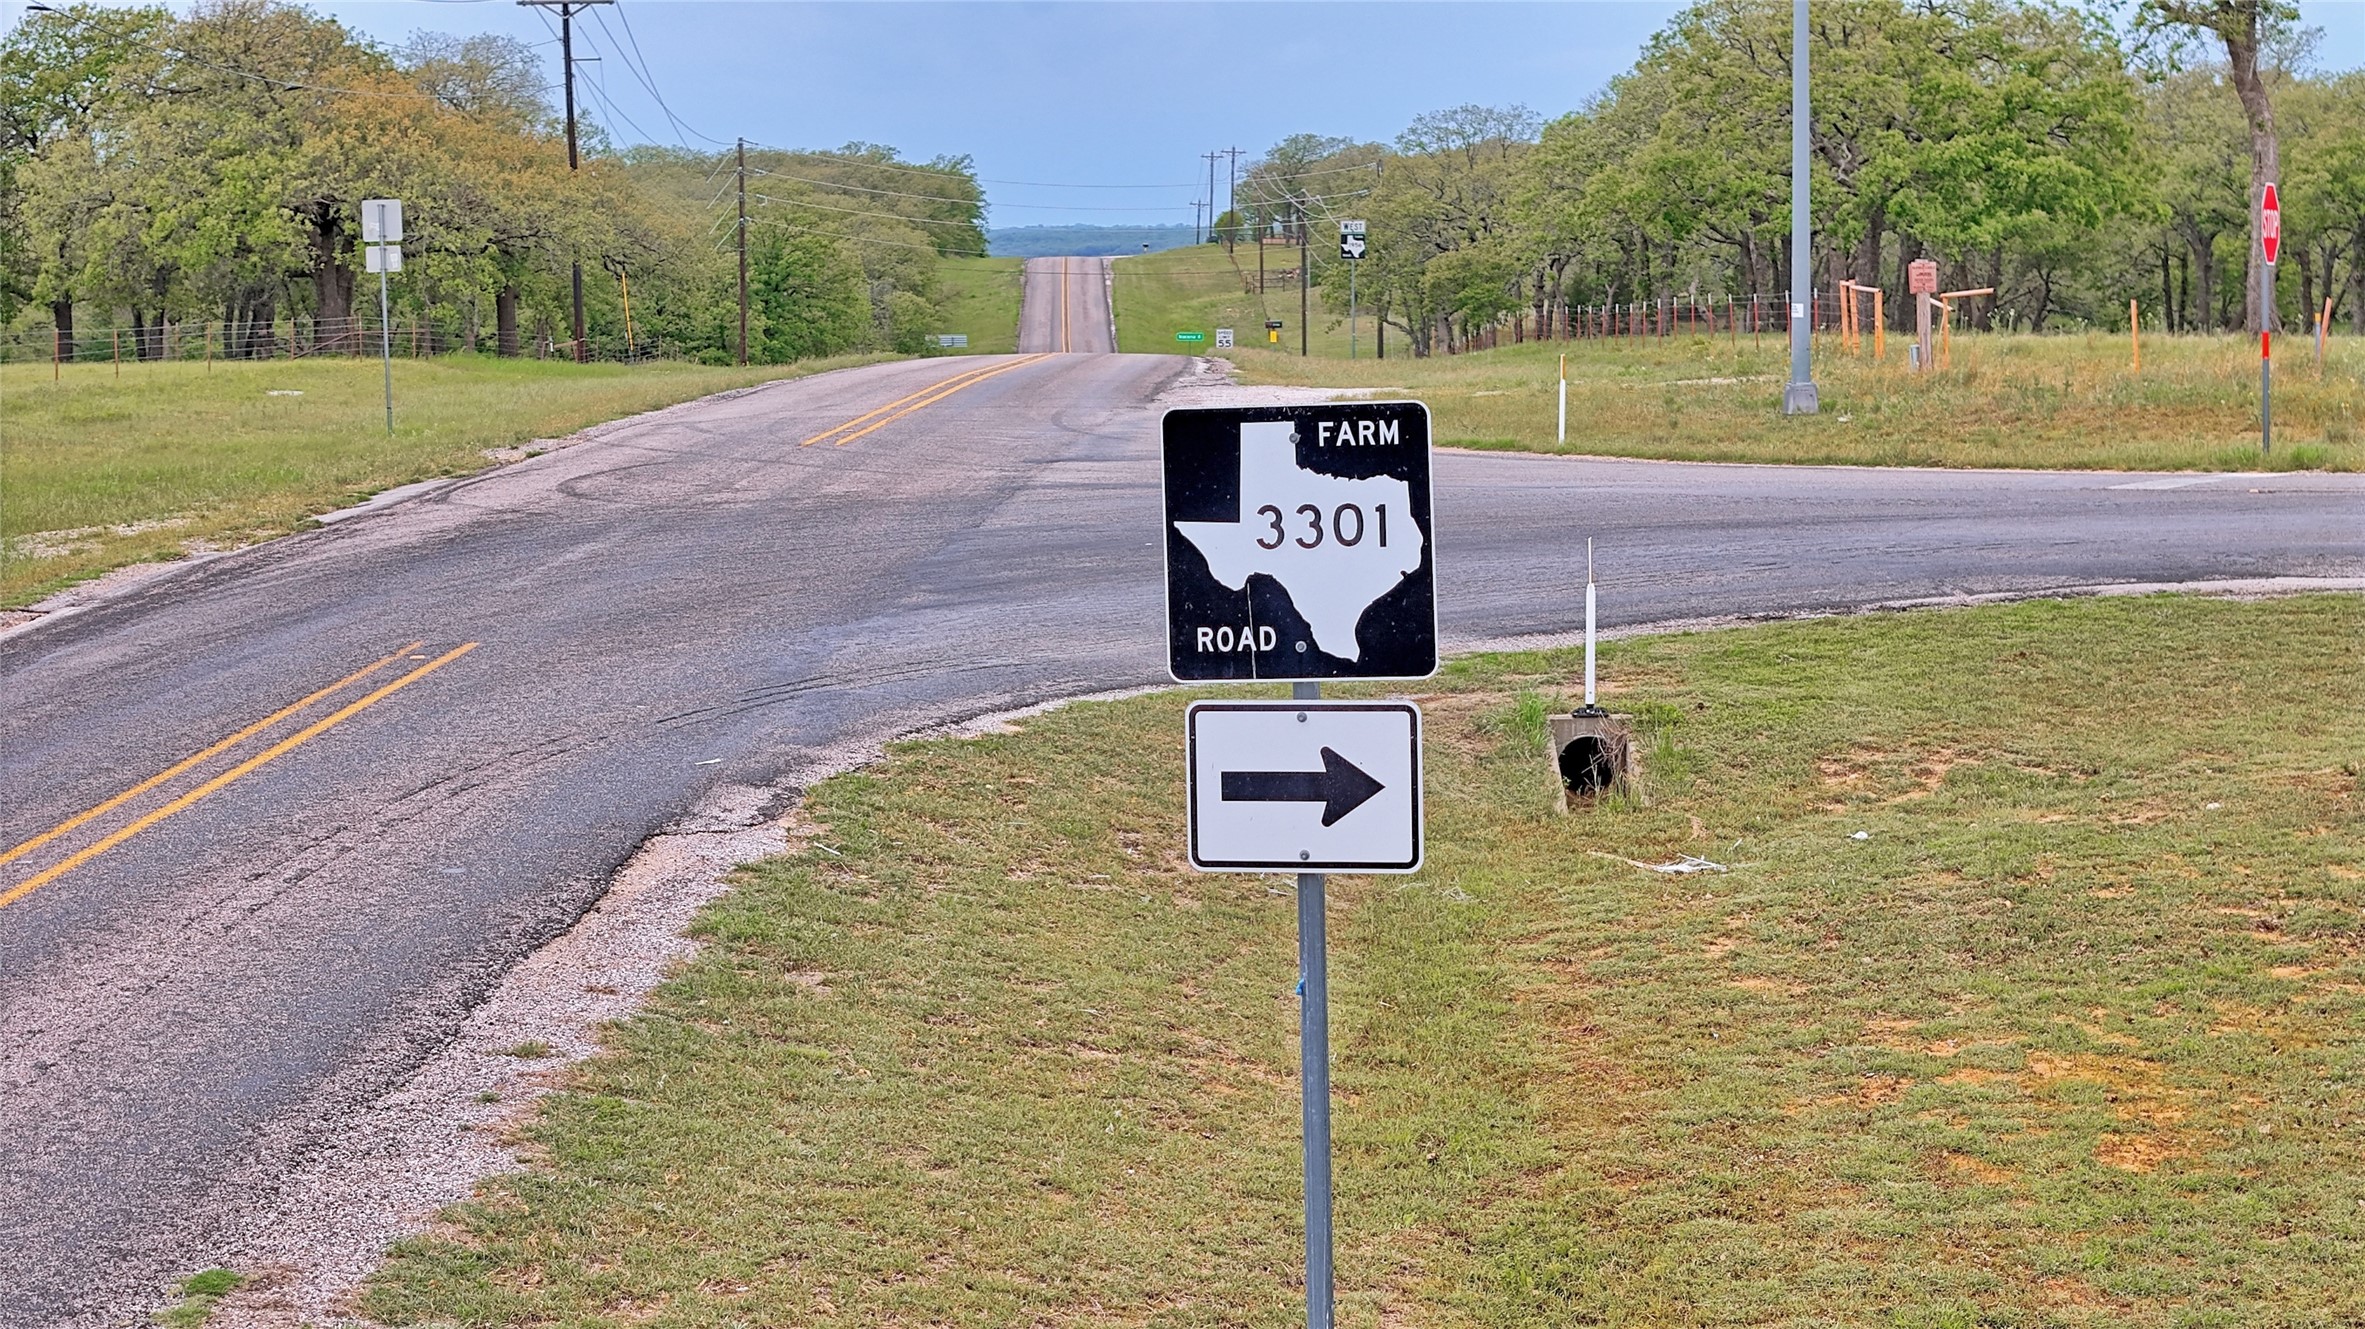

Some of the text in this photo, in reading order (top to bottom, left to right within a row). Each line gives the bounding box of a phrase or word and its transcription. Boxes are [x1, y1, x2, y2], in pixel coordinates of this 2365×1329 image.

[1342, 222, 1363, 230] WEST
[2263, 208, 2278, 239] STOP
[1218, 339, 1232, 348] 55
[1317, 419, 1400, 447] FARM
[1256, 502, 1388, 550] 3301
[1196, 625, 1277, 653] ROAD
